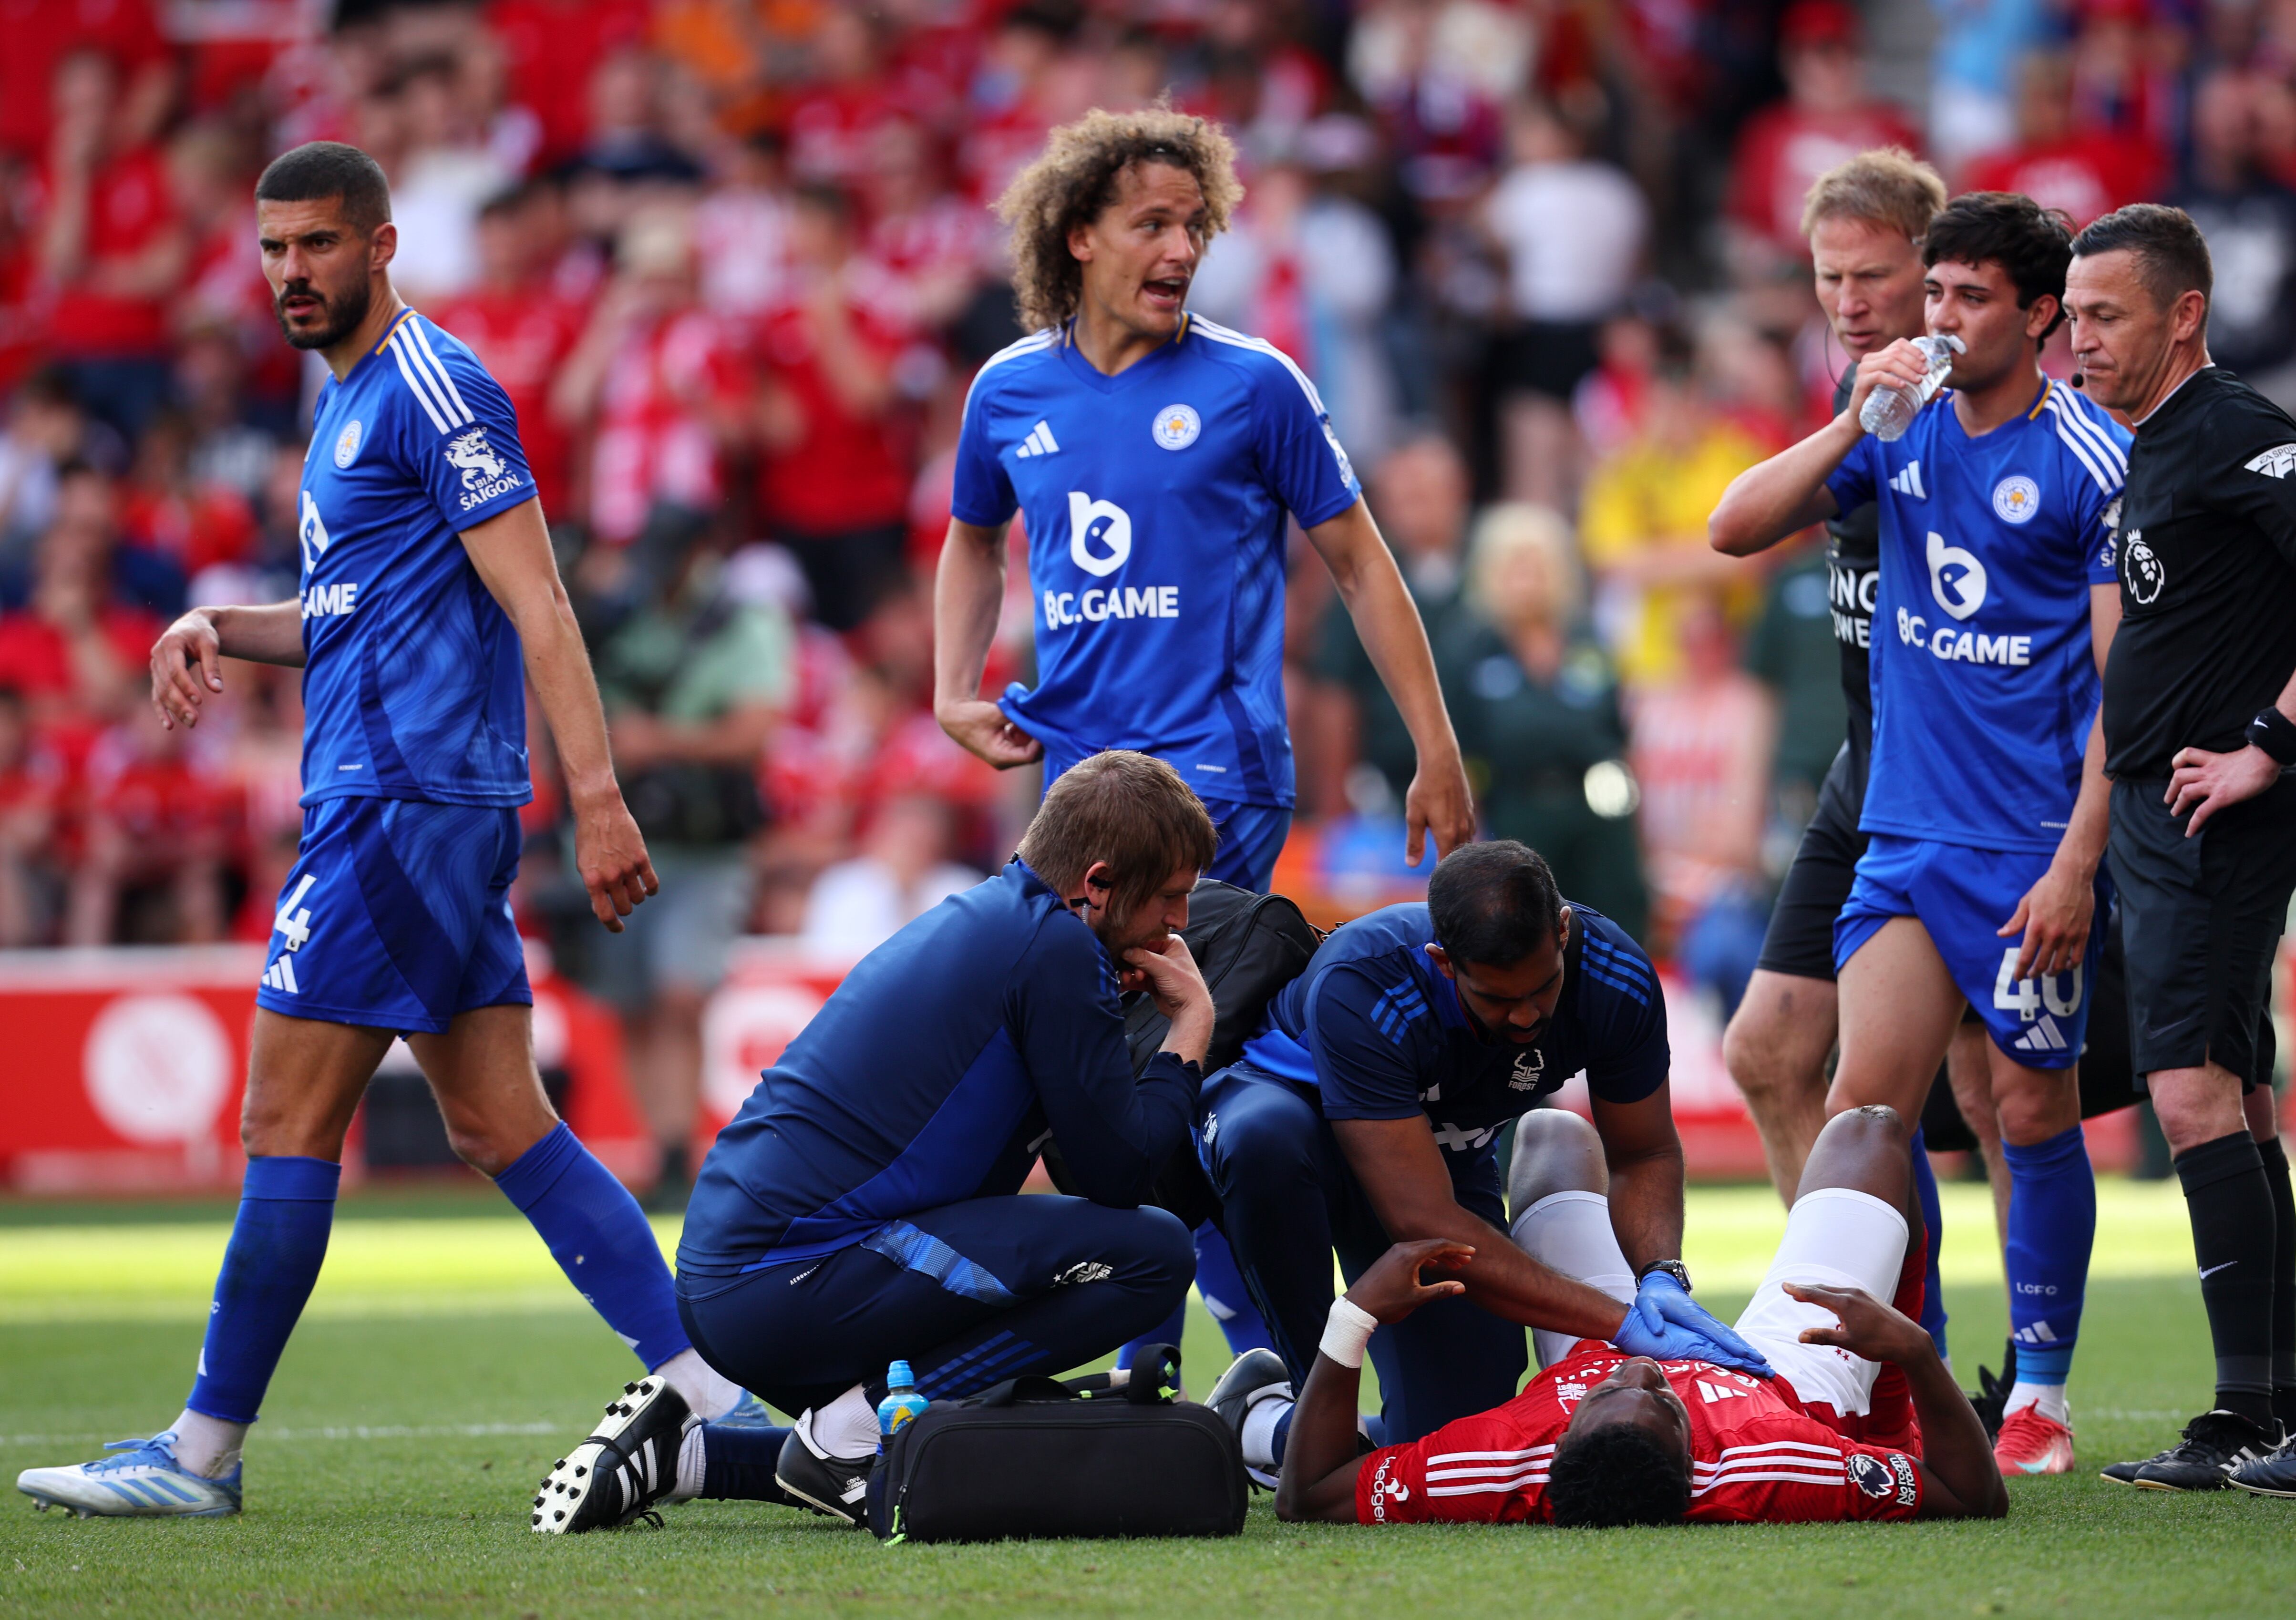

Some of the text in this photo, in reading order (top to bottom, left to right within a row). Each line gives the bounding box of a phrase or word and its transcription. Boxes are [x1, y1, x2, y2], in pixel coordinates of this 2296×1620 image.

[2259, 445, 2296, 464] EA SPOR
[460, 473, 521, 511] SAIGON
[474, 474, 495, 488] BIA
[1826, 558, 1880, 614] ING
[1043, 585, 1179, 631] BC.GAME
[1897, 606, 2031, 666] BC.GAME
[275, 873, 317, 953] 4
[1993, 947, 2083, 1022] 40
[2017, 1282, 2059, 1295] LCFC
[846, 1476, 861, 1486] COPA
[1889, 1457, 1908, 1505] No room
[1895, 1454, 1915, 1486] racism
